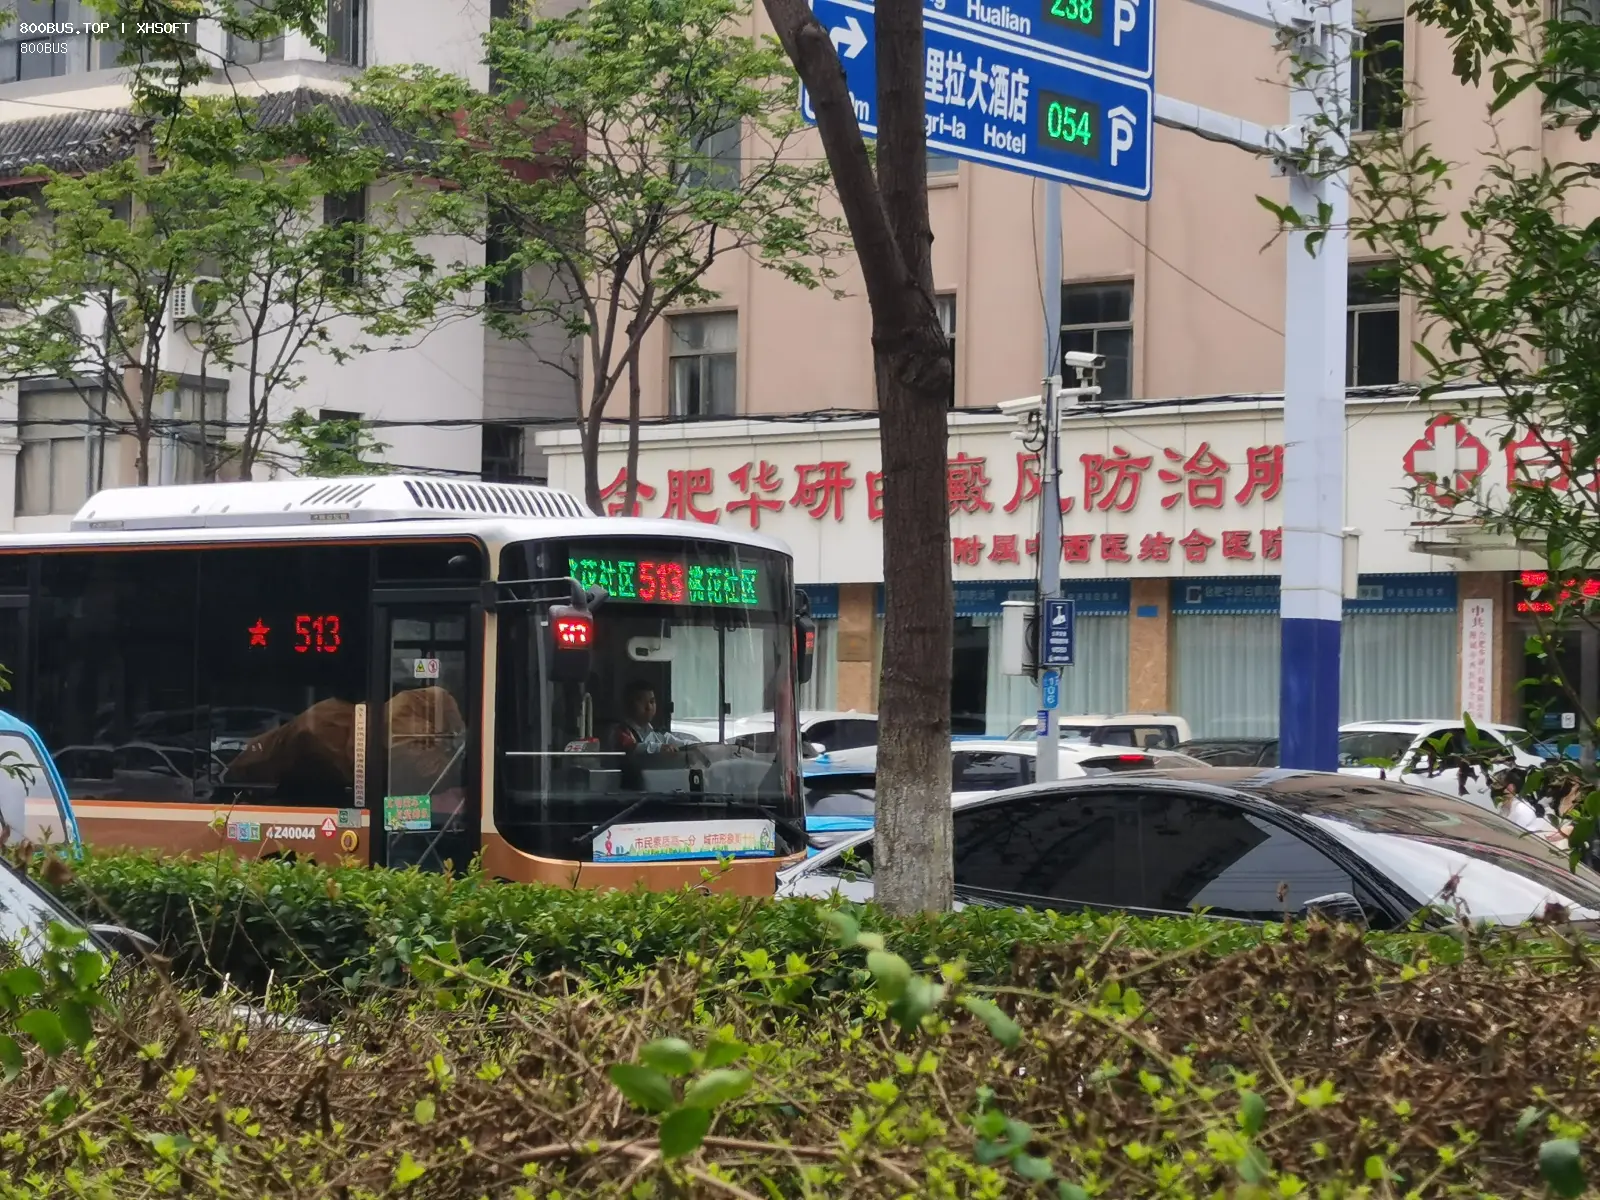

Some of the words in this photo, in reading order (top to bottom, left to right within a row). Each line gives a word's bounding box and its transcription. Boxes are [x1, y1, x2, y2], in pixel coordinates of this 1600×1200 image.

[967, 0, 1031, 35] Hualian
[924, 47, 1030, 125] 里拉大酒店
[983, 122, 1027, 155] Hotel
[1047, 101, 1091, 146] 054
[638, 561, 684, 602] 513
[294, 615, 341, 653] 513
[265, 825, 316, 840] 4Z40044
